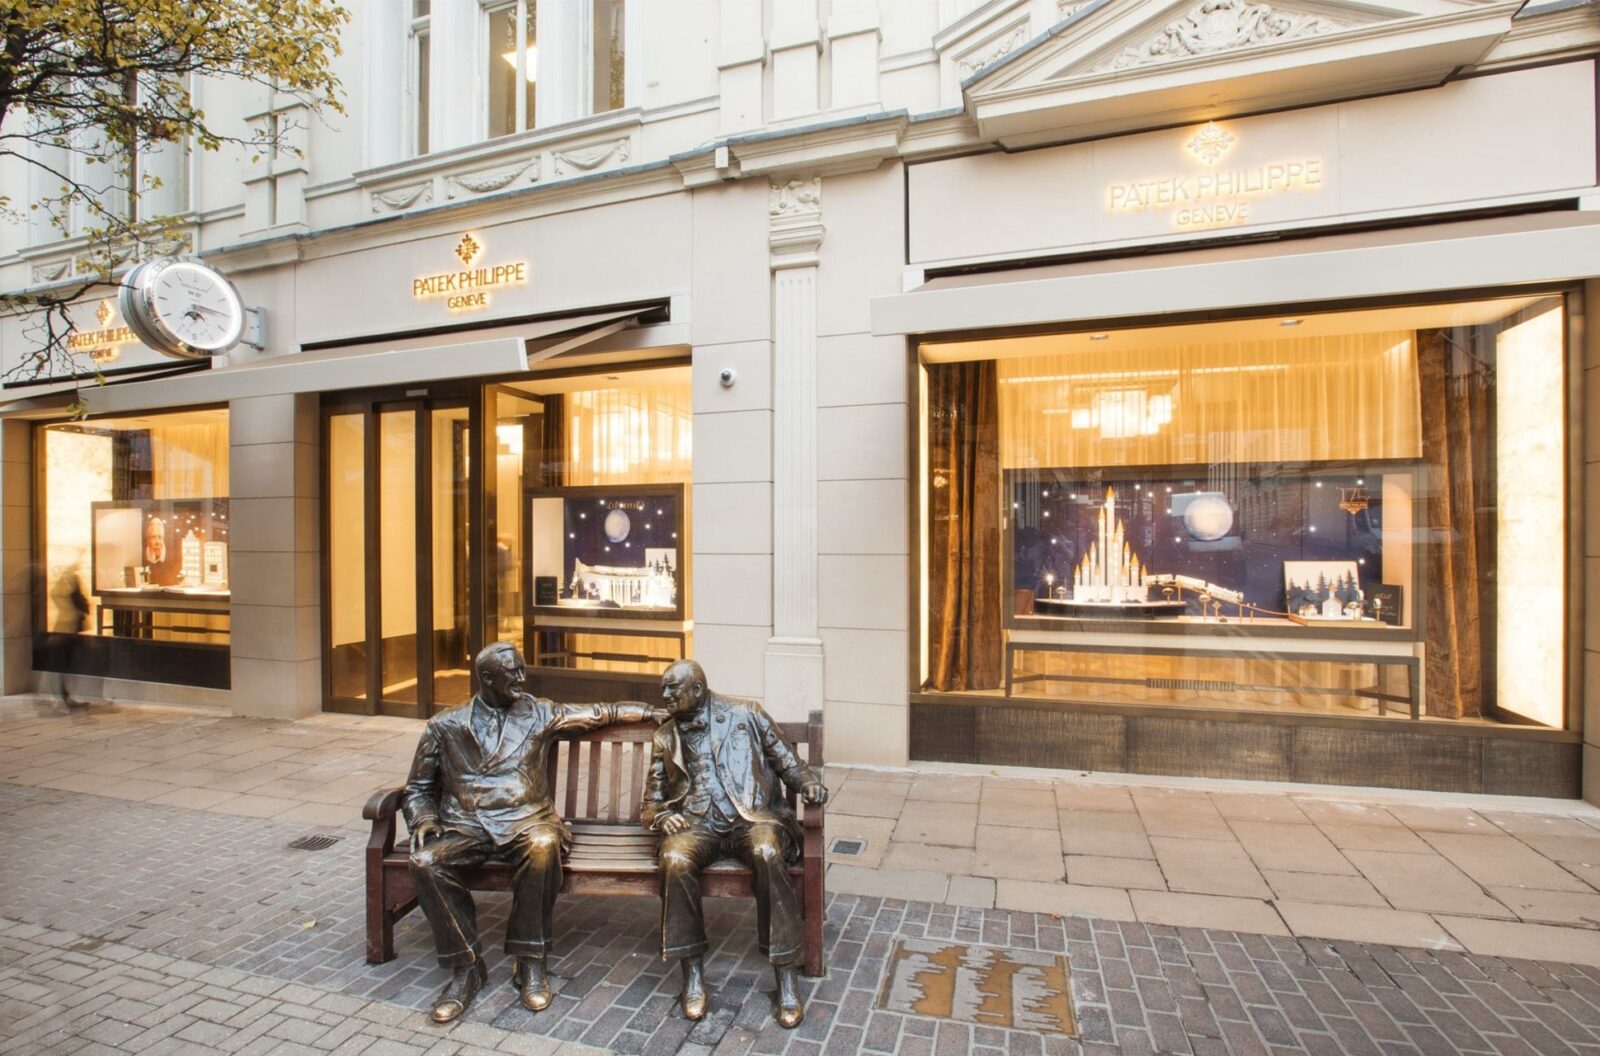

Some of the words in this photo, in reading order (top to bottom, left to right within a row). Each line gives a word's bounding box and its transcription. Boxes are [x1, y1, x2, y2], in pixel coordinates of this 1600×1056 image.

[1110, 176, 1190, 209] PATEK
[1197, 159, 1321, 198] PHILIPPE
[1176, 202, 1248, 226] GENEVE
[413, 273, 456, 296] PATEK
[459, 263, 525, 289] PHILIPPE
[447, 292, 487, 309] GENEVE
